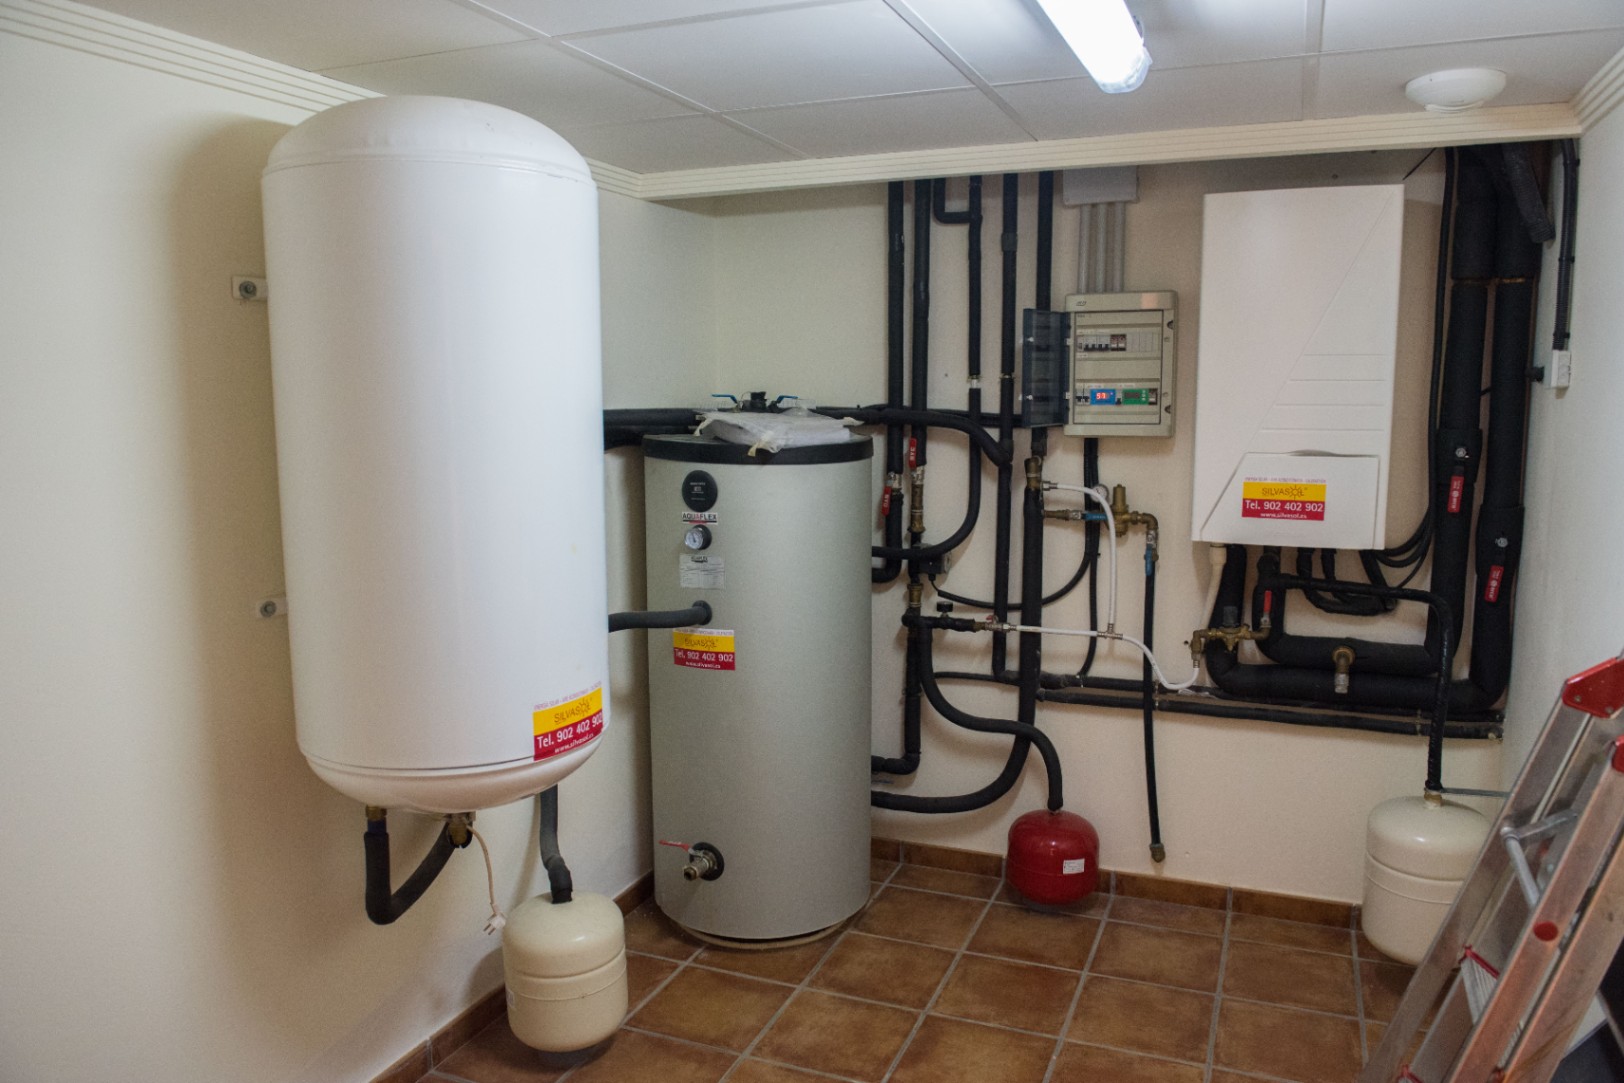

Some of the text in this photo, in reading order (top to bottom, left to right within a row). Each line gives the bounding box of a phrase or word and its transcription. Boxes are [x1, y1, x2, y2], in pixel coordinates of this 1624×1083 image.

[1262, 486, 1304, 499] SILVASOL
[1245, 500, 1323, 512] Tel. 902 402 902
[682, 513, 717, 521] AQUAFLEX
[675, 649, 733, 662] Tel. 902 402 902
[554, 698, 591, 724] SILVASOL
[537, 712, 603, 749] Tel. 902 402 902
